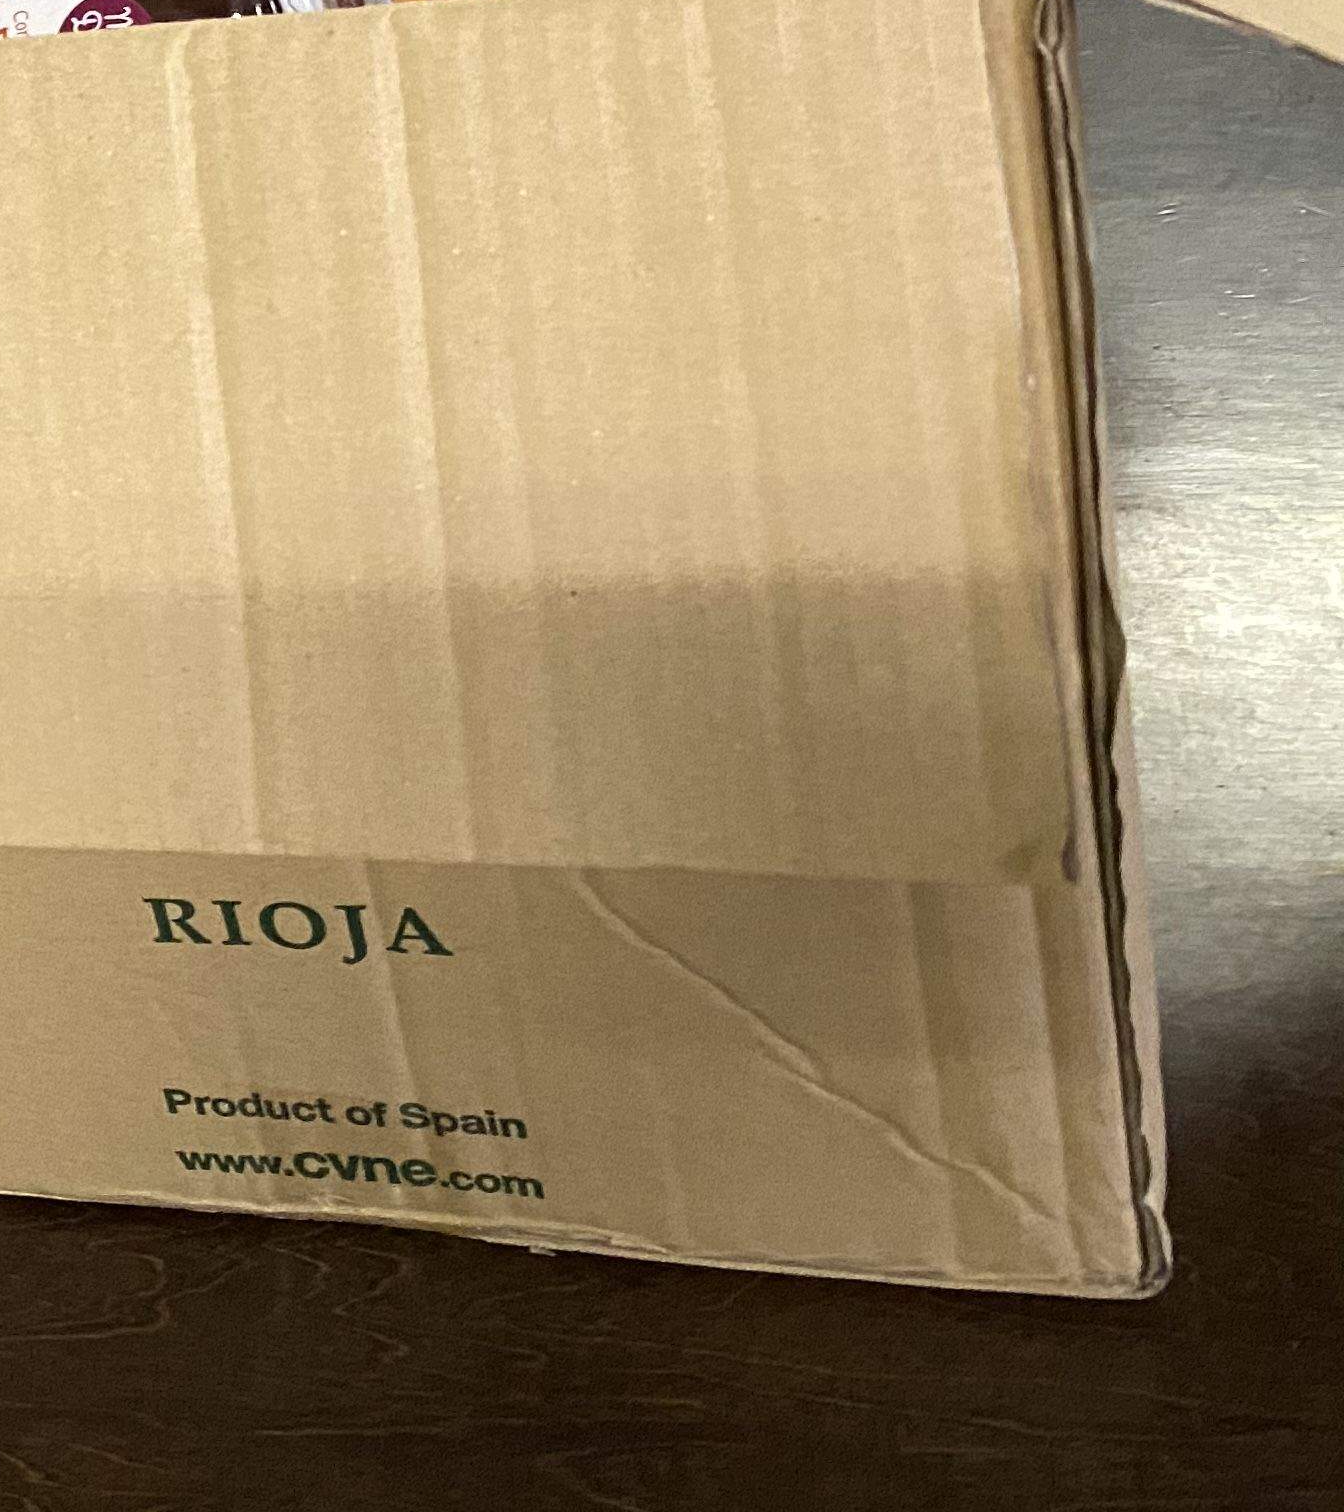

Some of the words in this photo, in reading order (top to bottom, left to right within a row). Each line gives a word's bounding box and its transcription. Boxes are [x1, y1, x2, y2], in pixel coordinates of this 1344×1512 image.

[143, 895, 455, 965] RIOJA
[162, 1087, 335, 1128] Product
[341, 1100, 391, 1130] of
[397, 1103, 528, 1141] Spain
[173, 1144, 545, 1201] www.cvne.com
